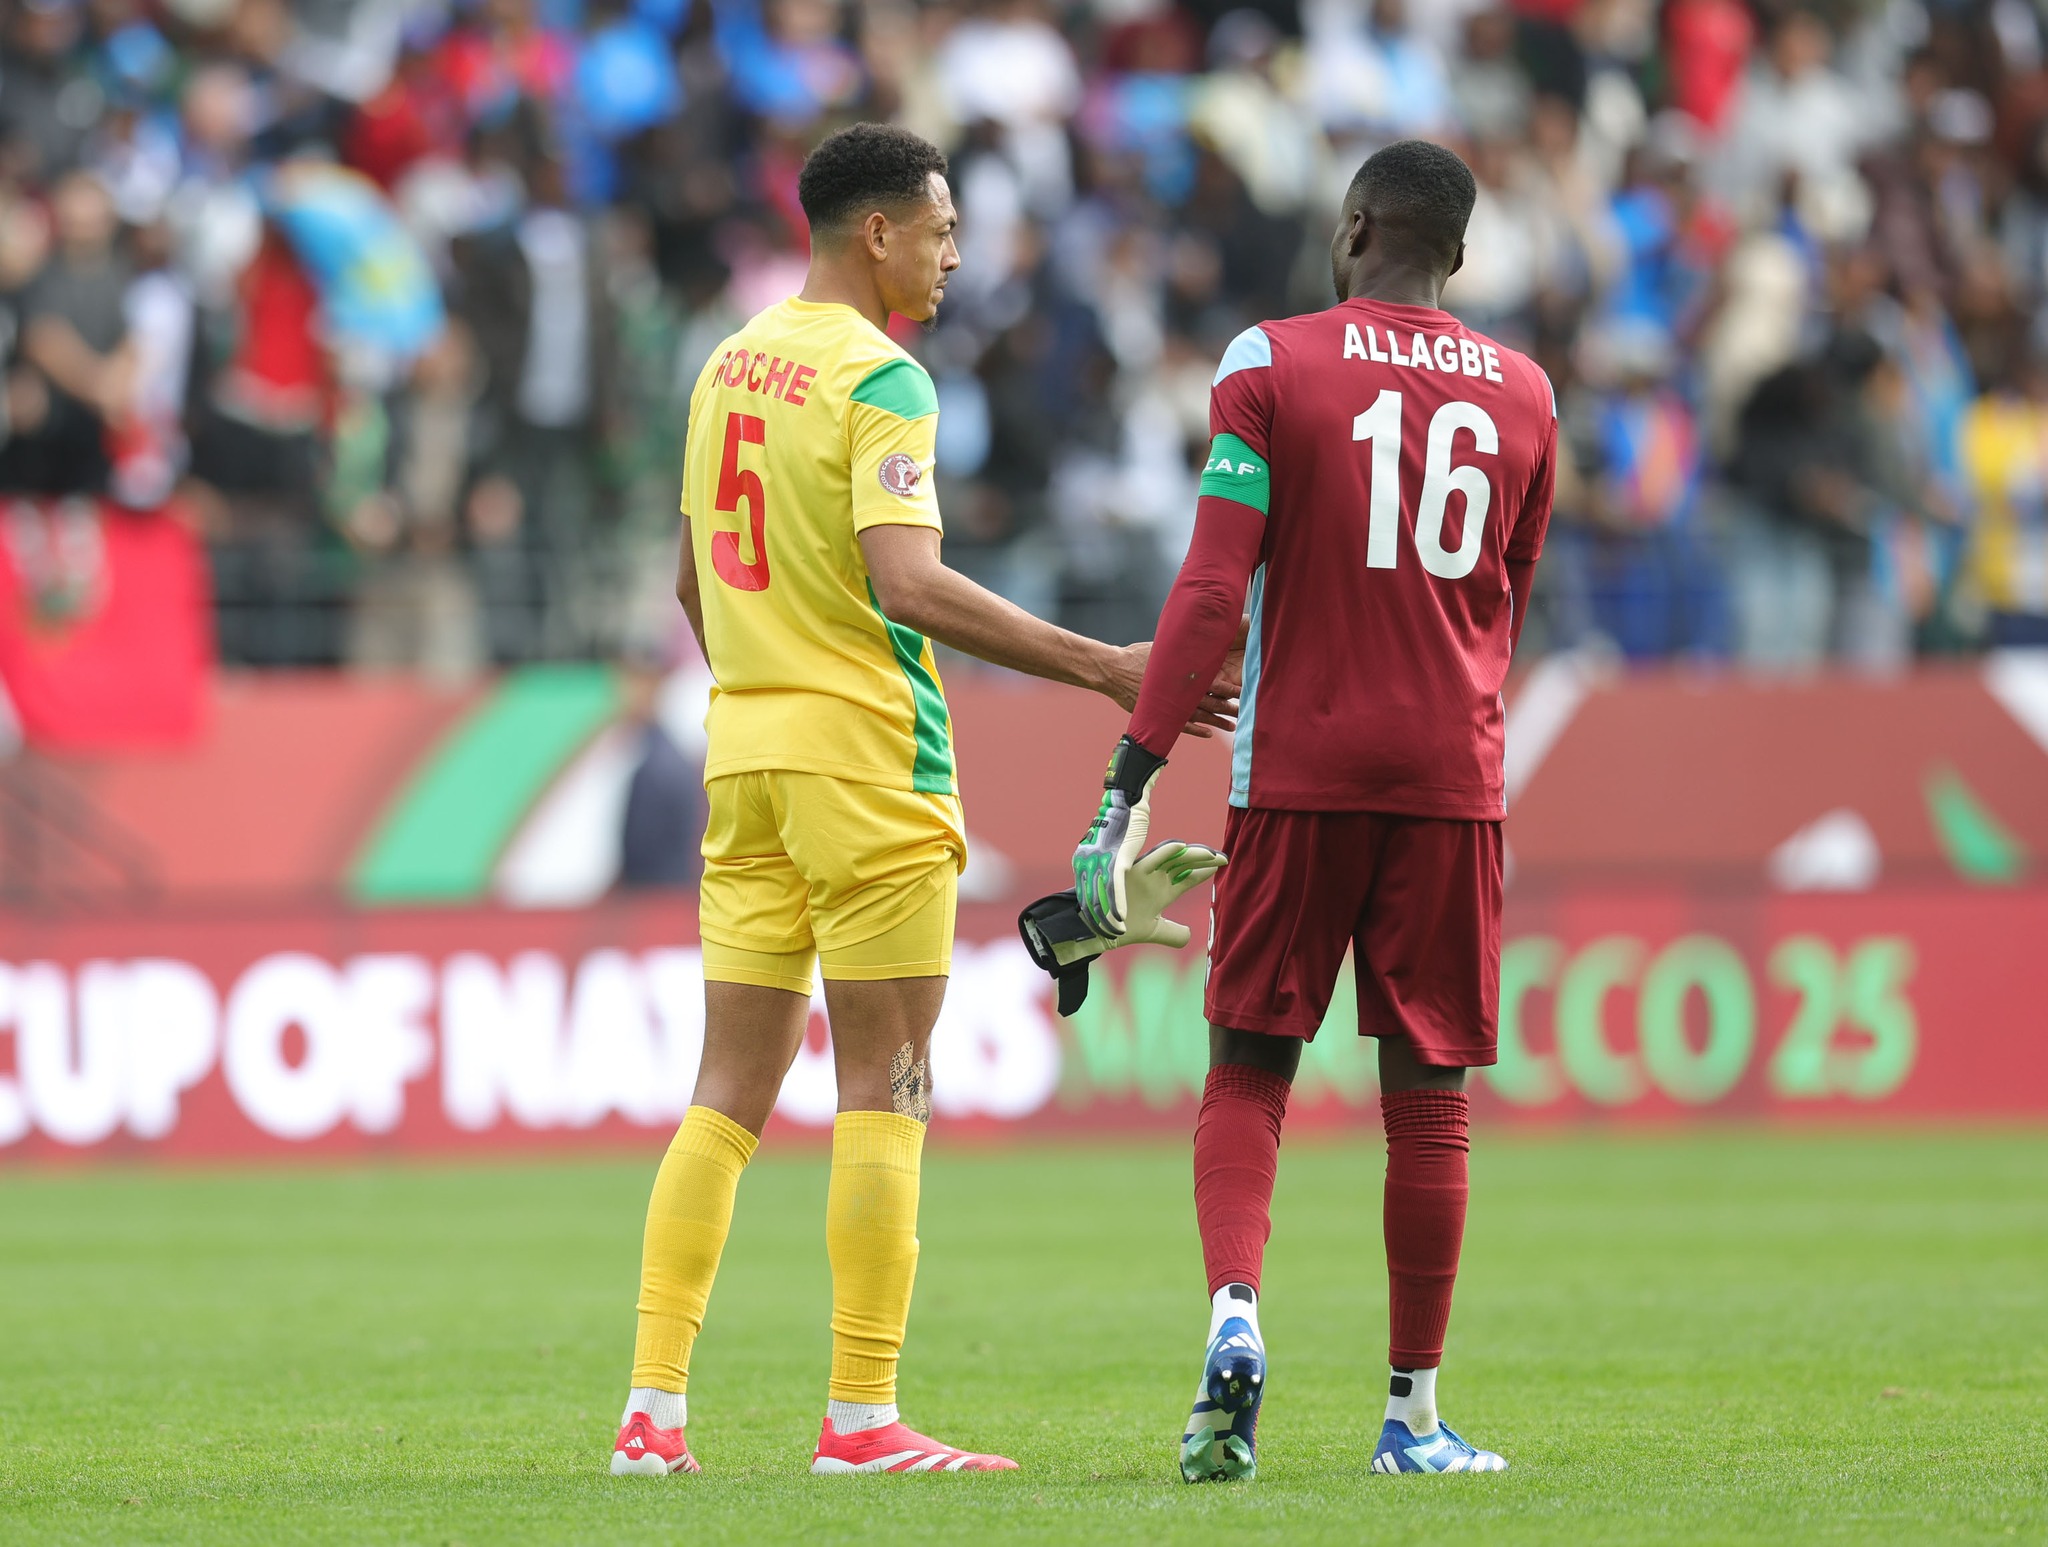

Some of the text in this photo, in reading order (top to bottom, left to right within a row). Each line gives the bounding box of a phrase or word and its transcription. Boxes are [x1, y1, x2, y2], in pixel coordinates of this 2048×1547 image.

[1342, 323, 1503, 384] ALLAGBE
[711, 412, 771, 592] 5
[1352, 388, 1500, 580] 16
[222, 950, 435, 1141] OF
[1766, 933, 1919, 1101] 25
